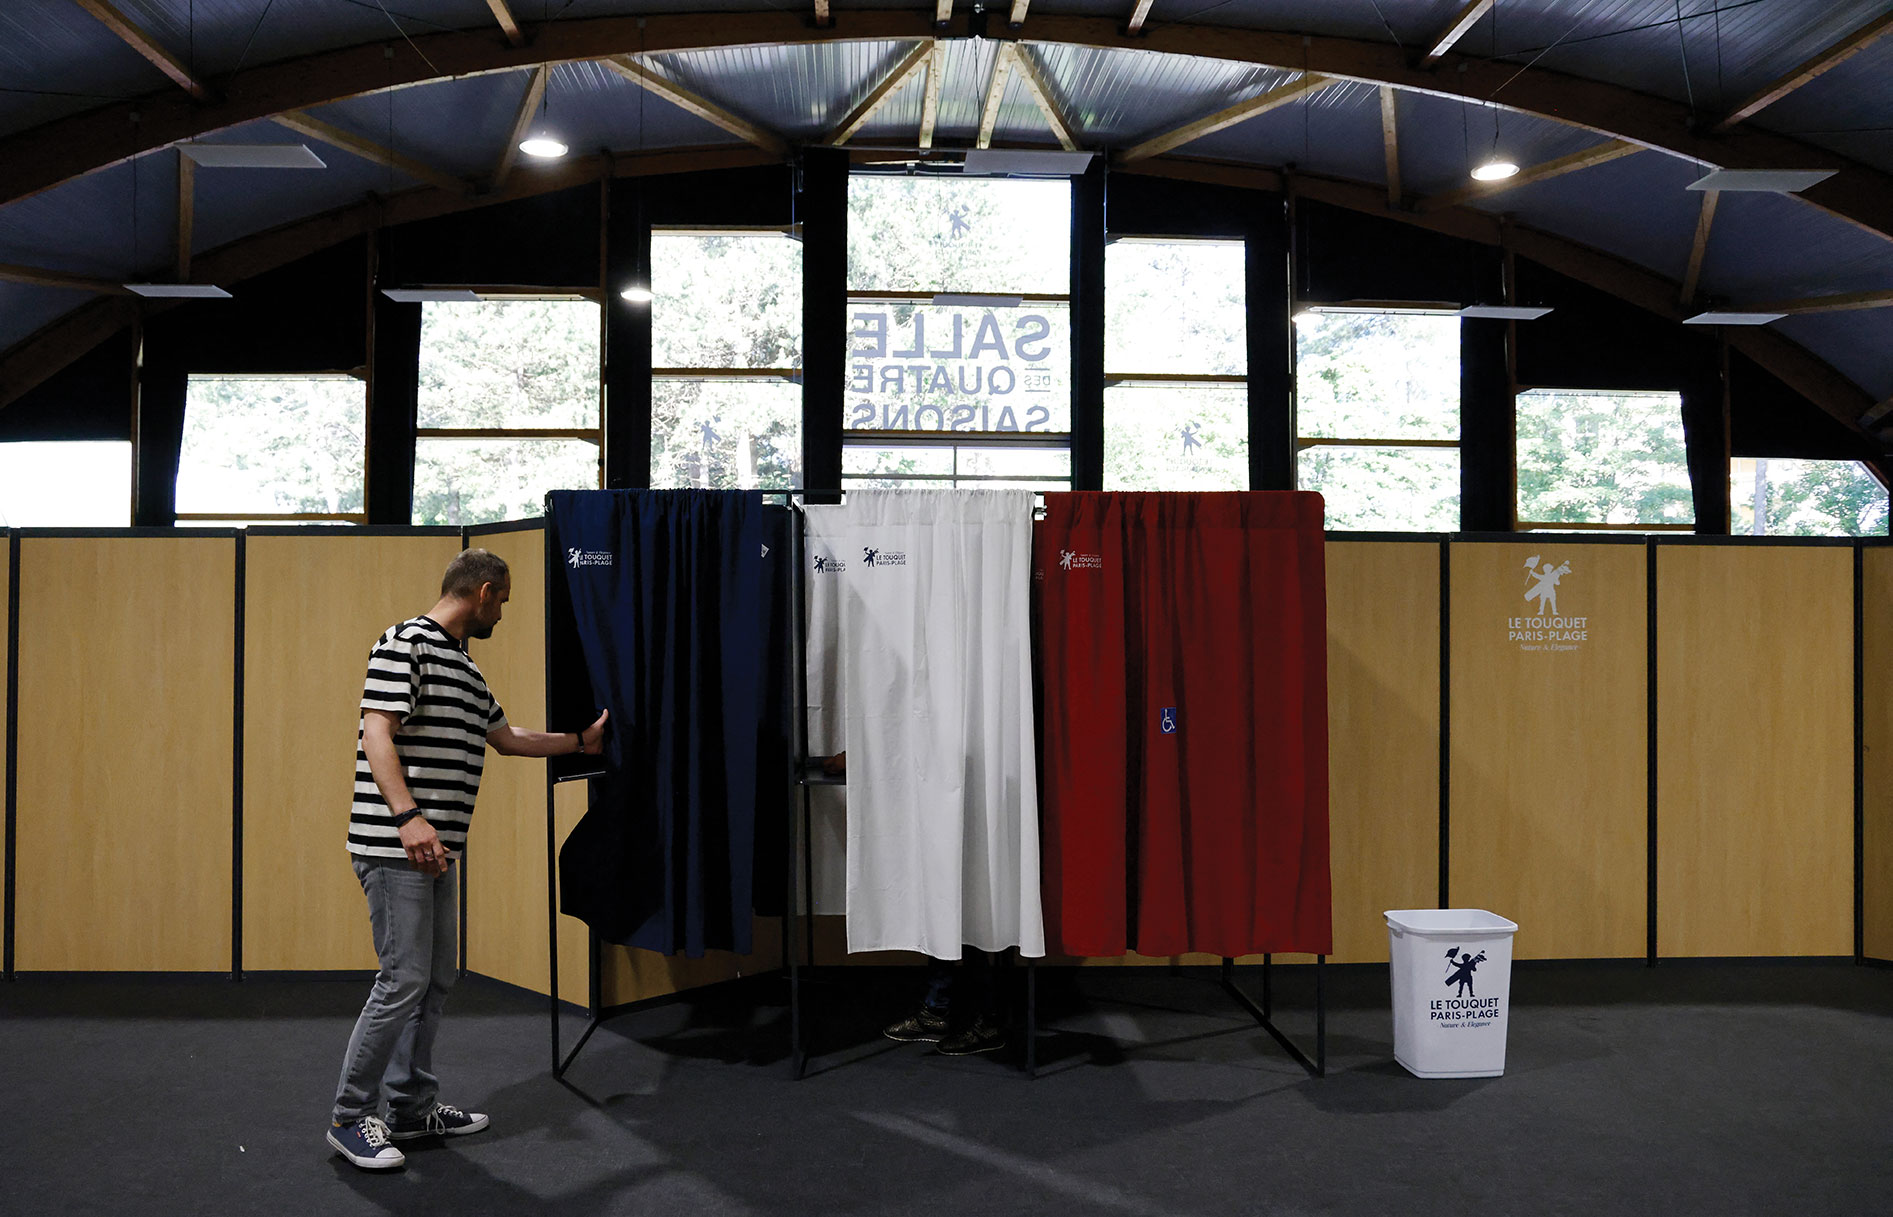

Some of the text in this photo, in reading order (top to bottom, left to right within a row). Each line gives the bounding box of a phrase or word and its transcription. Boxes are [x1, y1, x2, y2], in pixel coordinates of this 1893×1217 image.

[1508, 617, 1588, 629] LE TOUQUET
[1508, 631, 1588, 641] PARIS-PLAGE
[1430, 997, 1499, 1010] LE TOUQUET
[1430, 1009, 1499, 1020] PARIS-PLAGE
